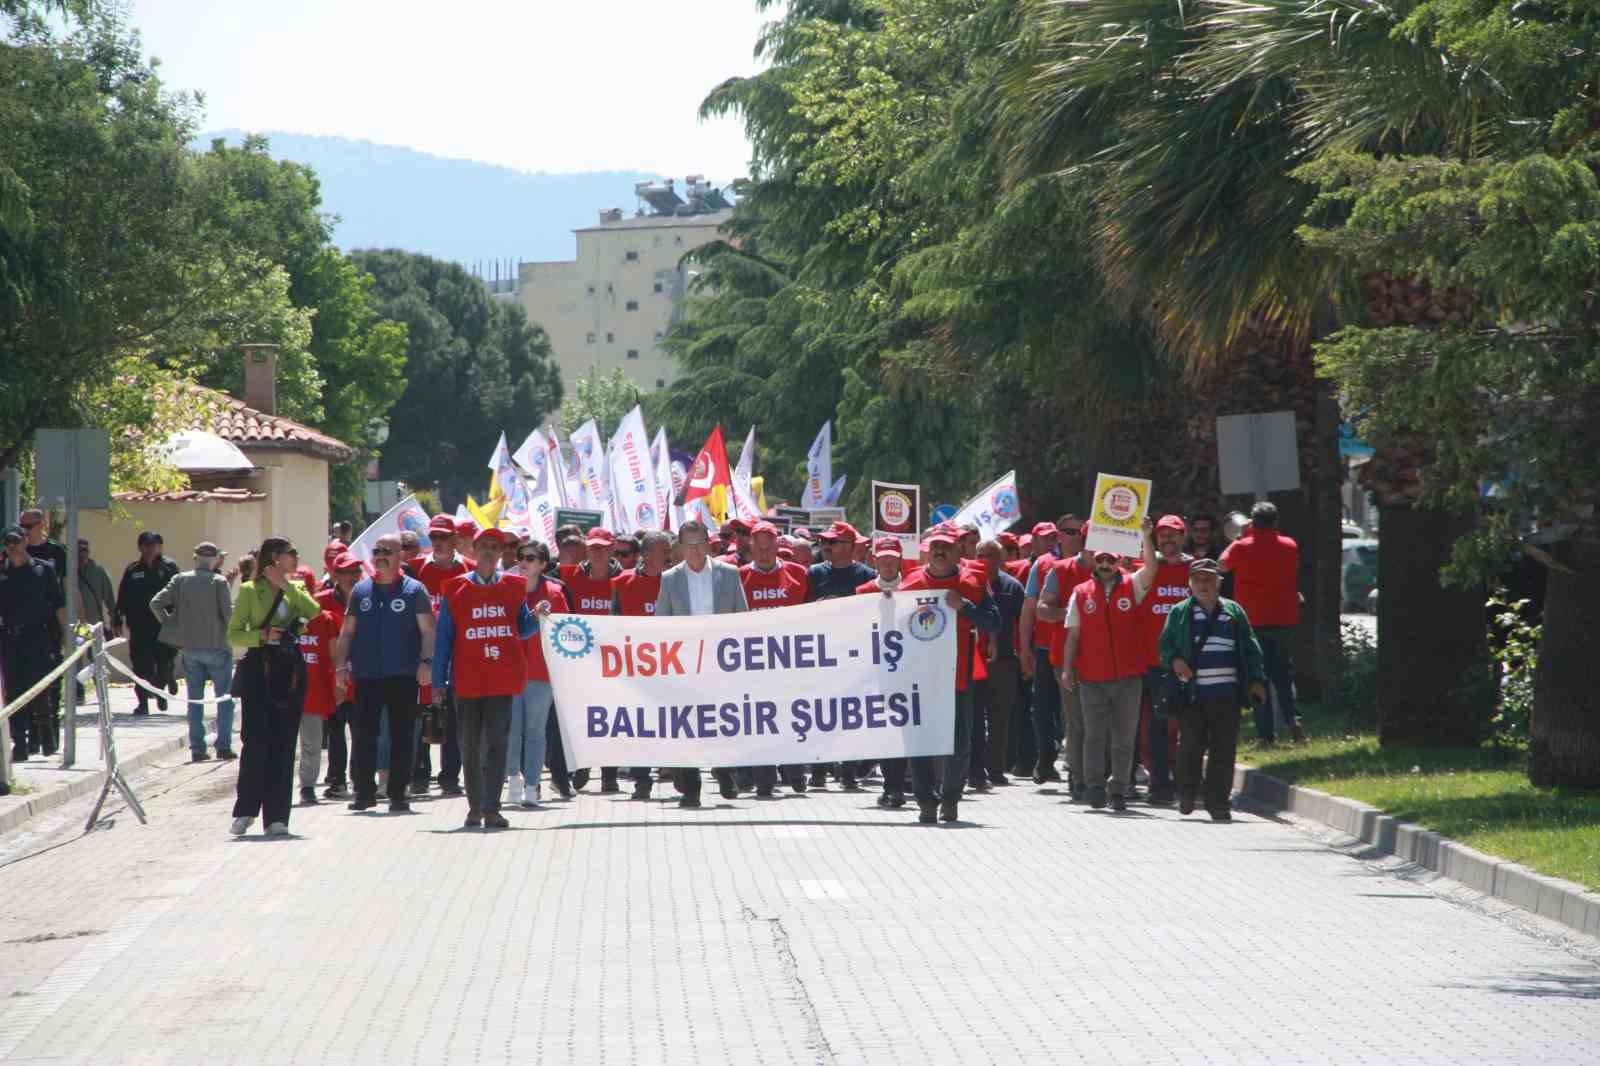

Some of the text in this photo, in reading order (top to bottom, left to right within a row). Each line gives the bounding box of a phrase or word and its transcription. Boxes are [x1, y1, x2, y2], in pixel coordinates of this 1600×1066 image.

[752, 588, 788, 600] DİSK
[472, 604, 506, 619] DİSK
[465, 625, 513, 640] GENEL
[600, 635, 685, 678] DİSK
[696, 639, 705, 674] /
[716, 633, 838, 672] GENEL
[871, 622, 904, 672] İŞ
[586, 683, 922, 743] BALIKESİR ŞUBESİ
